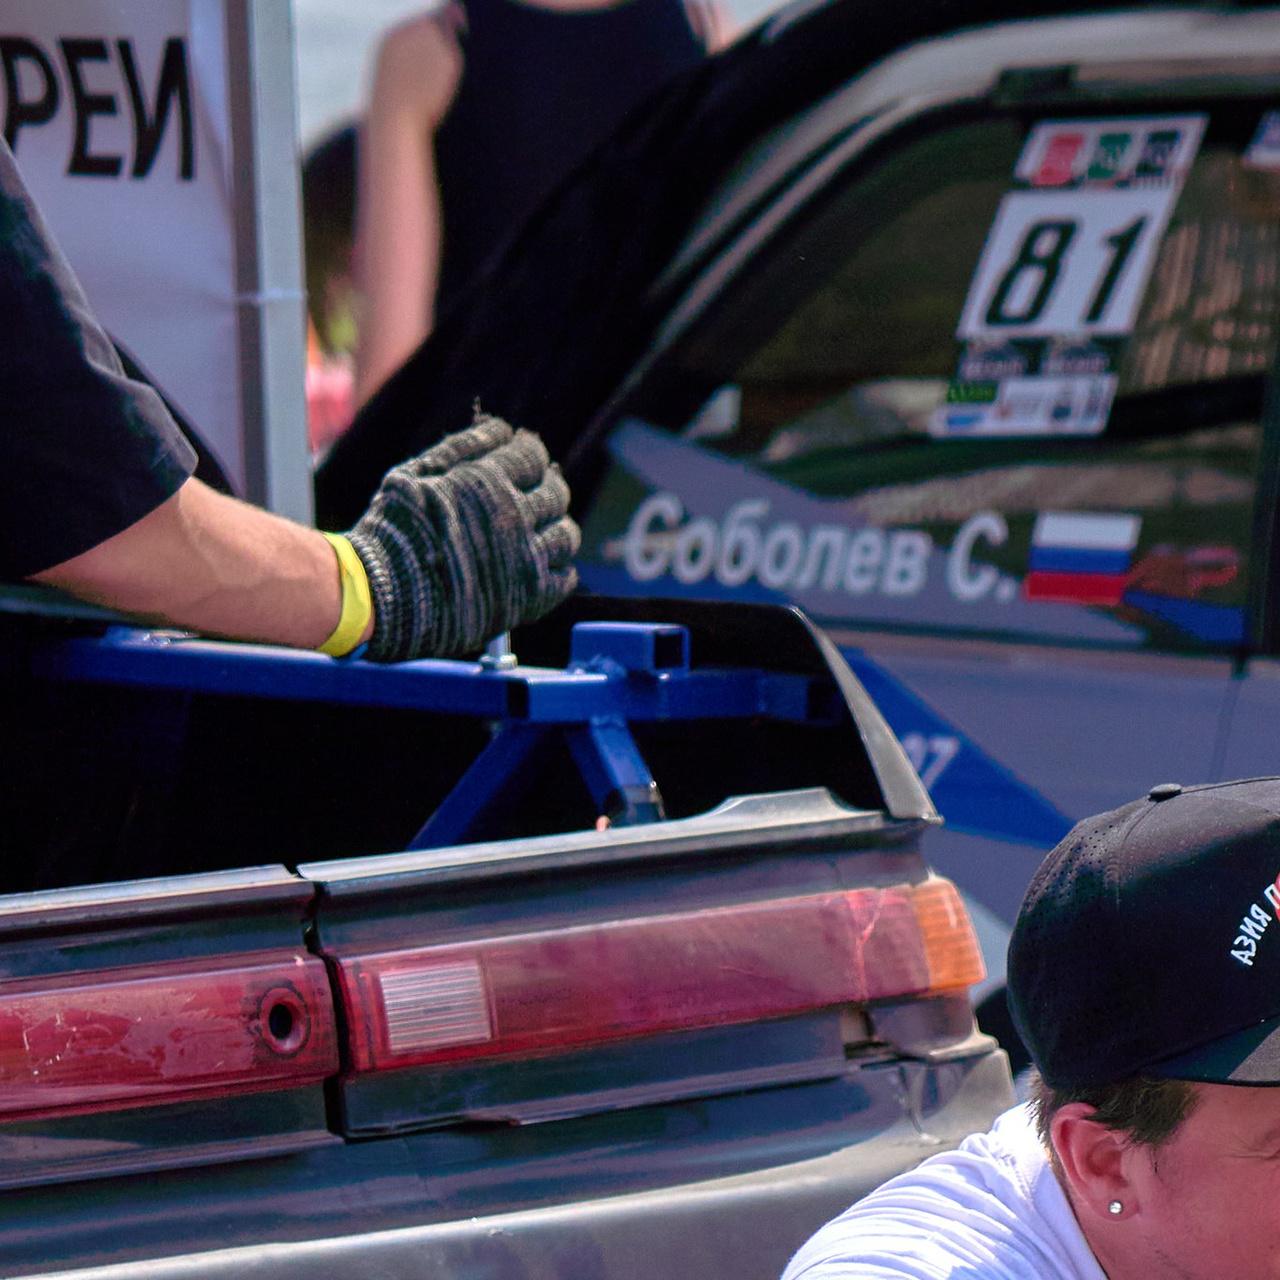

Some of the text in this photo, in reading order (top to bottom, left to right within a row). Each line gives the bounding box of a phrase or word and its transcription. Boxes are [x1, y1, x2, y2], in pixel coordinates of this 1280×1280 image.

[982, 215, 1149, 328] 81
[622, 494, 1020, 600] Соболев С.
[1230, 902, 1272, 966] АЗИЯ
